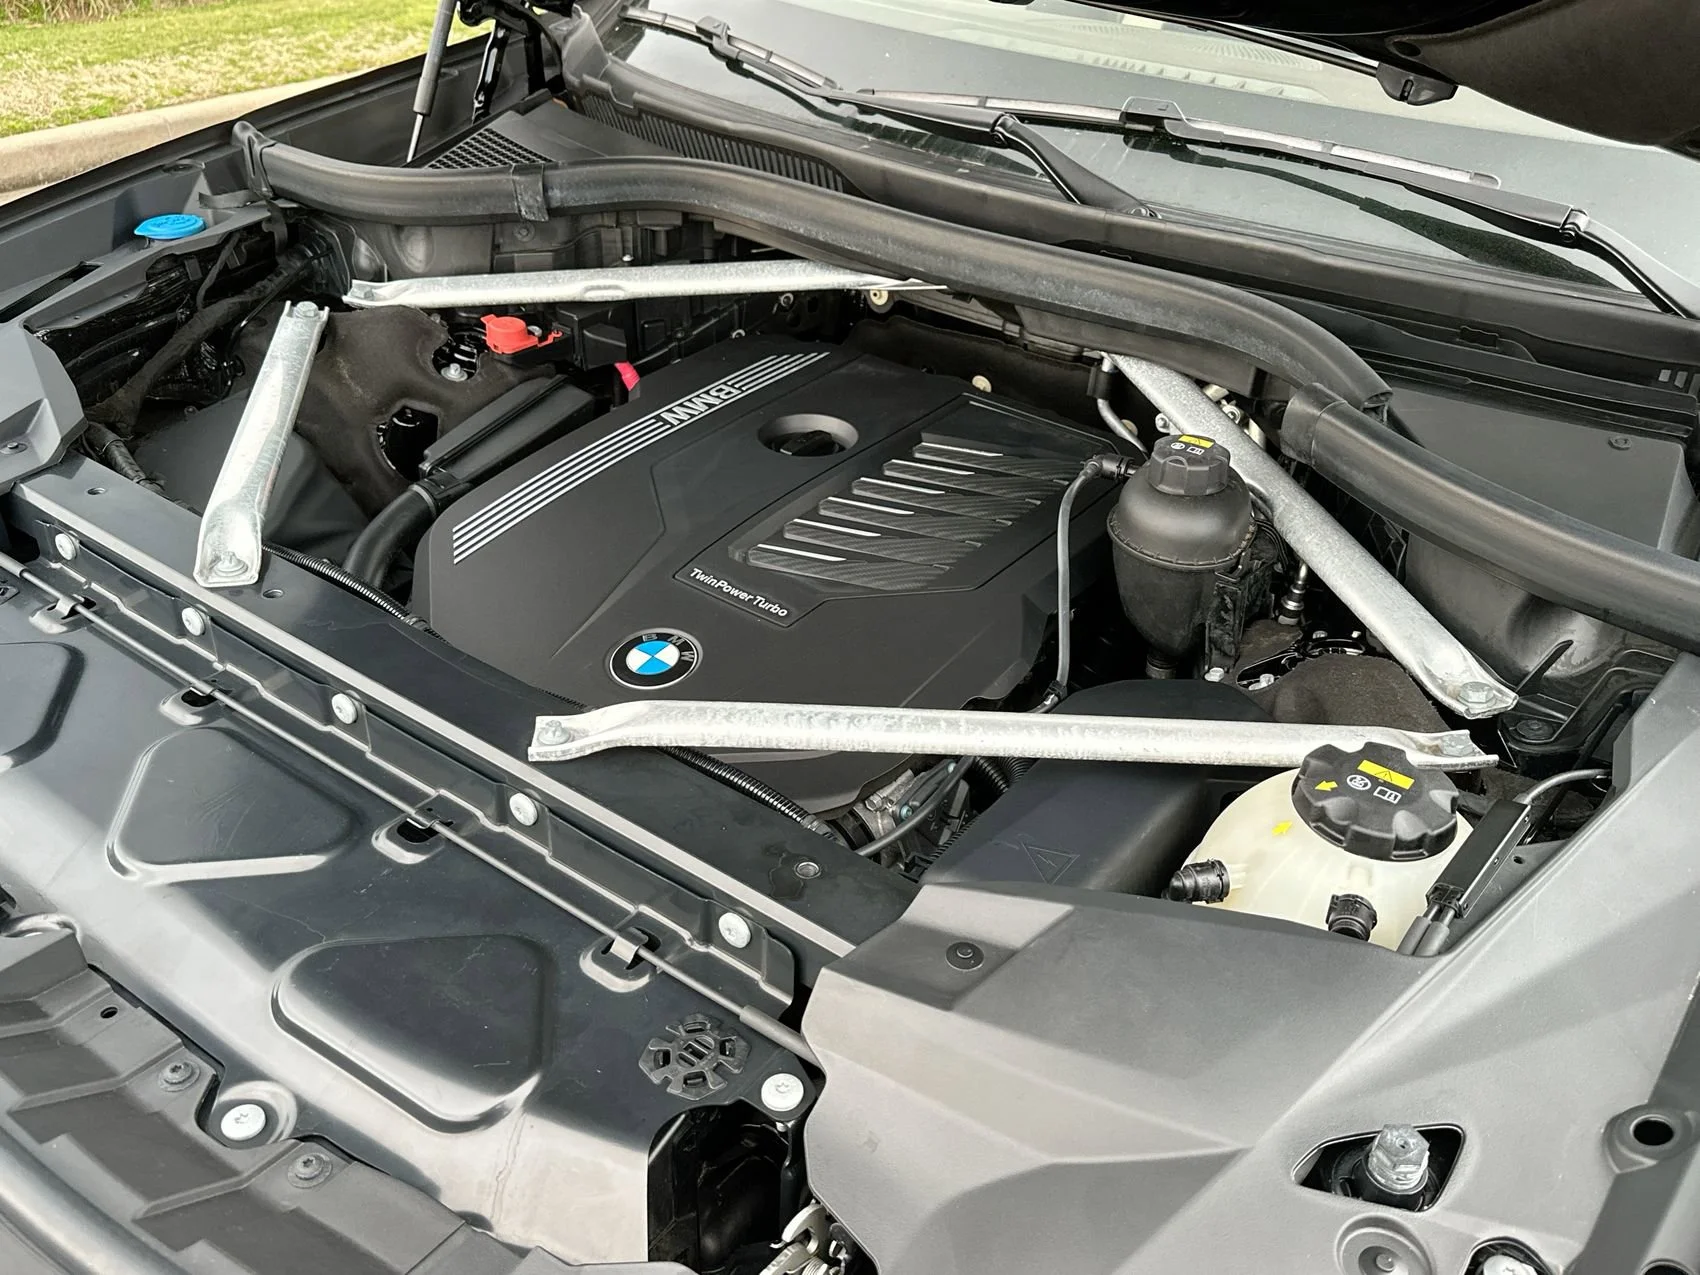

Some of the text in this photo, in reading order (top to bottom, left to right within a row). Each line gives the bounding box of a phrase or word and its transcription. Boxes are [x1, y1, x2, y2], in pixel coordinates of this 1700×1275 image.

[659, 383, 742, 426] BMW
[689, 567, 788, 617] TwinPower Turbo
[642, 633, 695, 662] BMW
